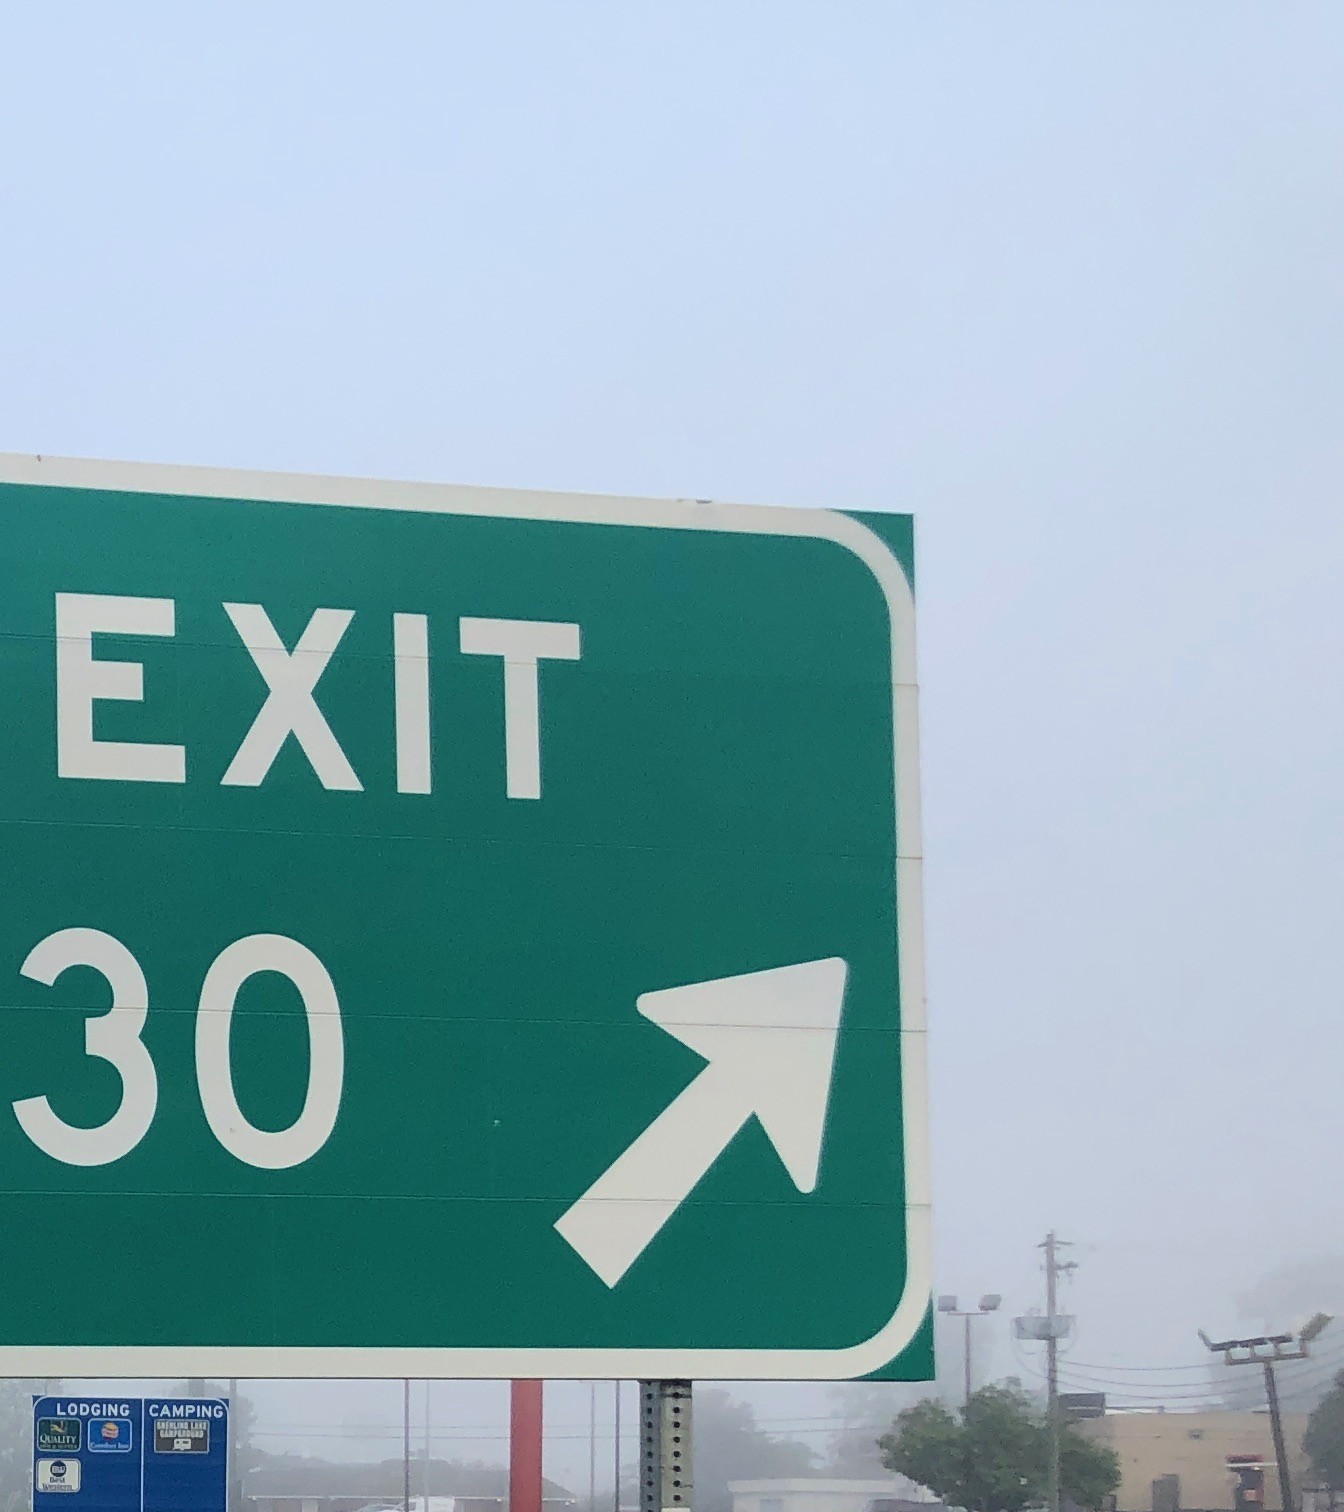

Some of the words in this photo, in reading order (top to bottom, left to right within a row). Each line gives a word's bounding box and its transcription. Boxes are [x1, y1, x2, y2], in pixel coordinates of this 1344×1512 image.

[55, 592, 580, 800] EXIT
[56, 1402, 130, 1417] LODGING
[149, 1404, 224, 1418] CAMPING
[39, 1434, 77, 1444] QUALITY
